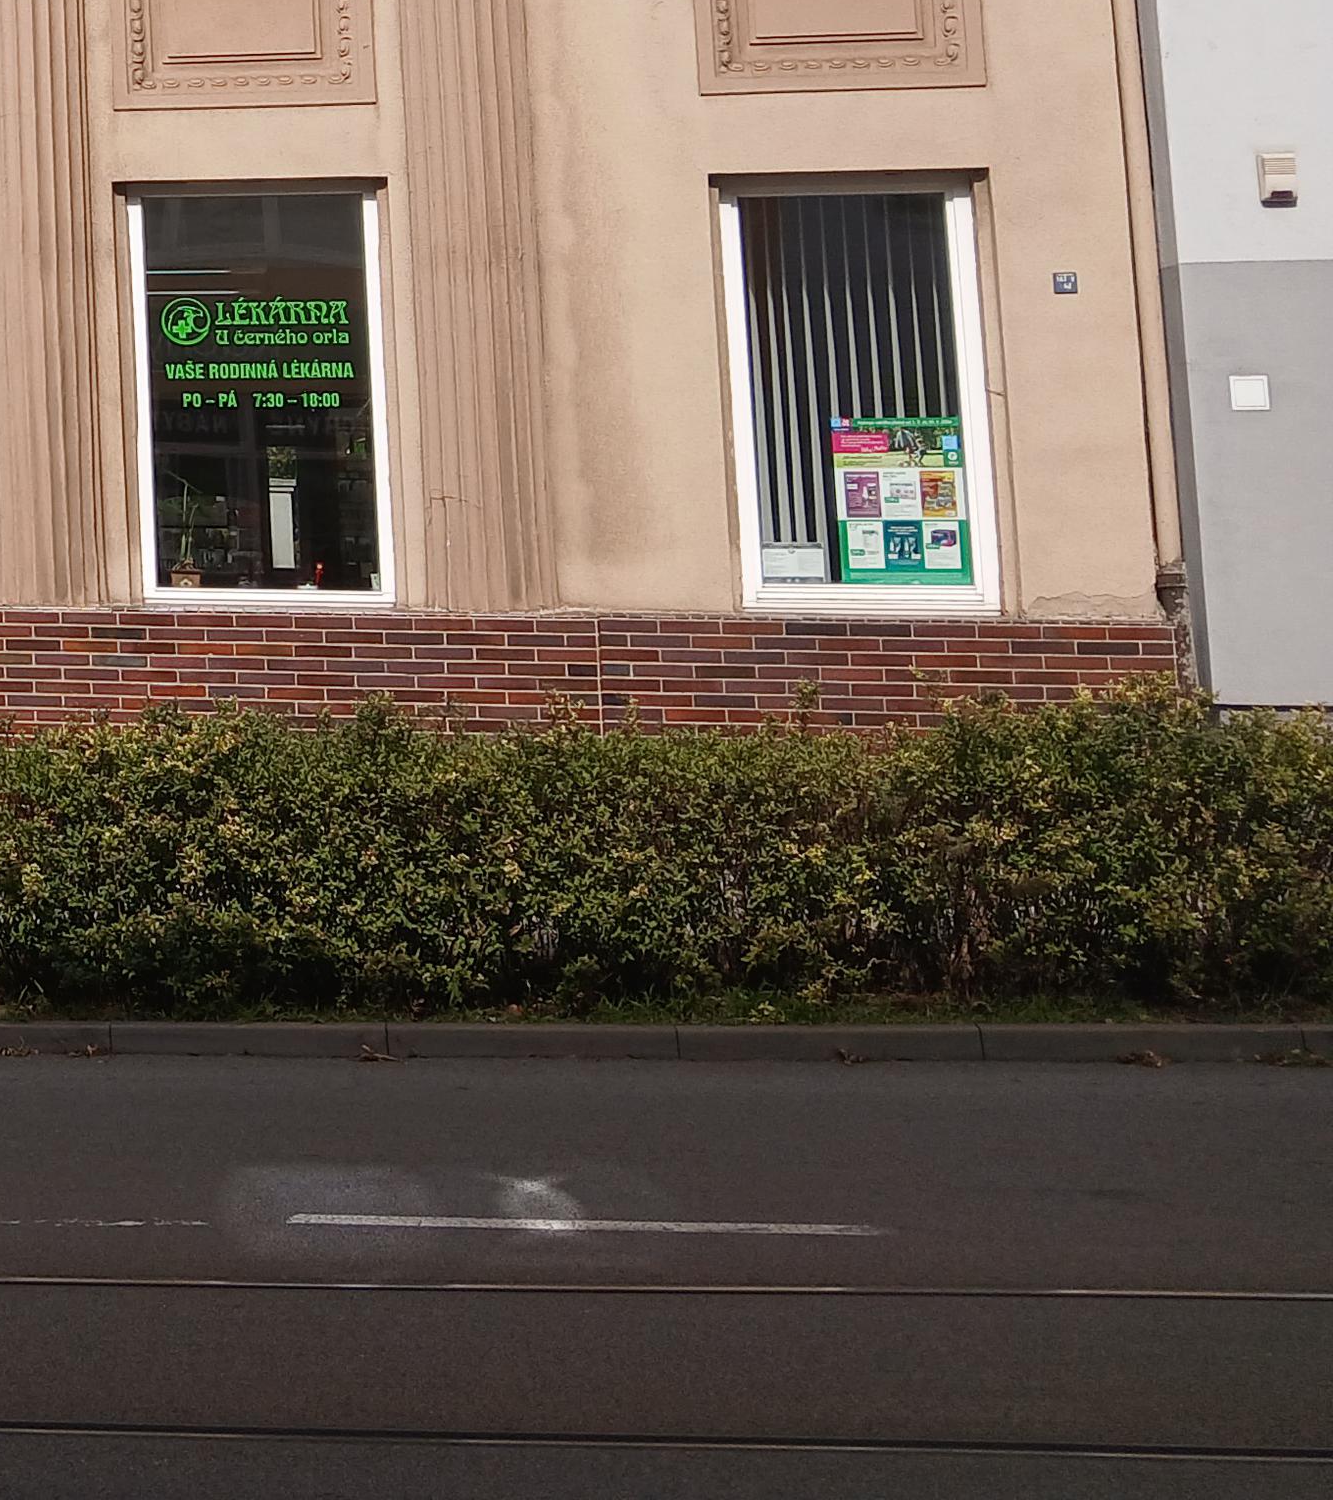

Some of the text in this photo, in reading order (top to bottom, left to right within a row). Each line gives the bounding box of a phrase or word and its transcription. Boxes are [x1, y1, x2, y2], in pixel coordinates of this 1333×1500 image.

[215, 296, 350, 325] LÉKÁRNA
[215, 329, 350, 345] U černého orla
[165, 359, 354, 379] VAŠE RODINNÁ LÉKÁRNA
[182, 393, 201, 408] PO
[218, 390, 237, 408] PÁ
[253, 393, 284, 408] 7:30
